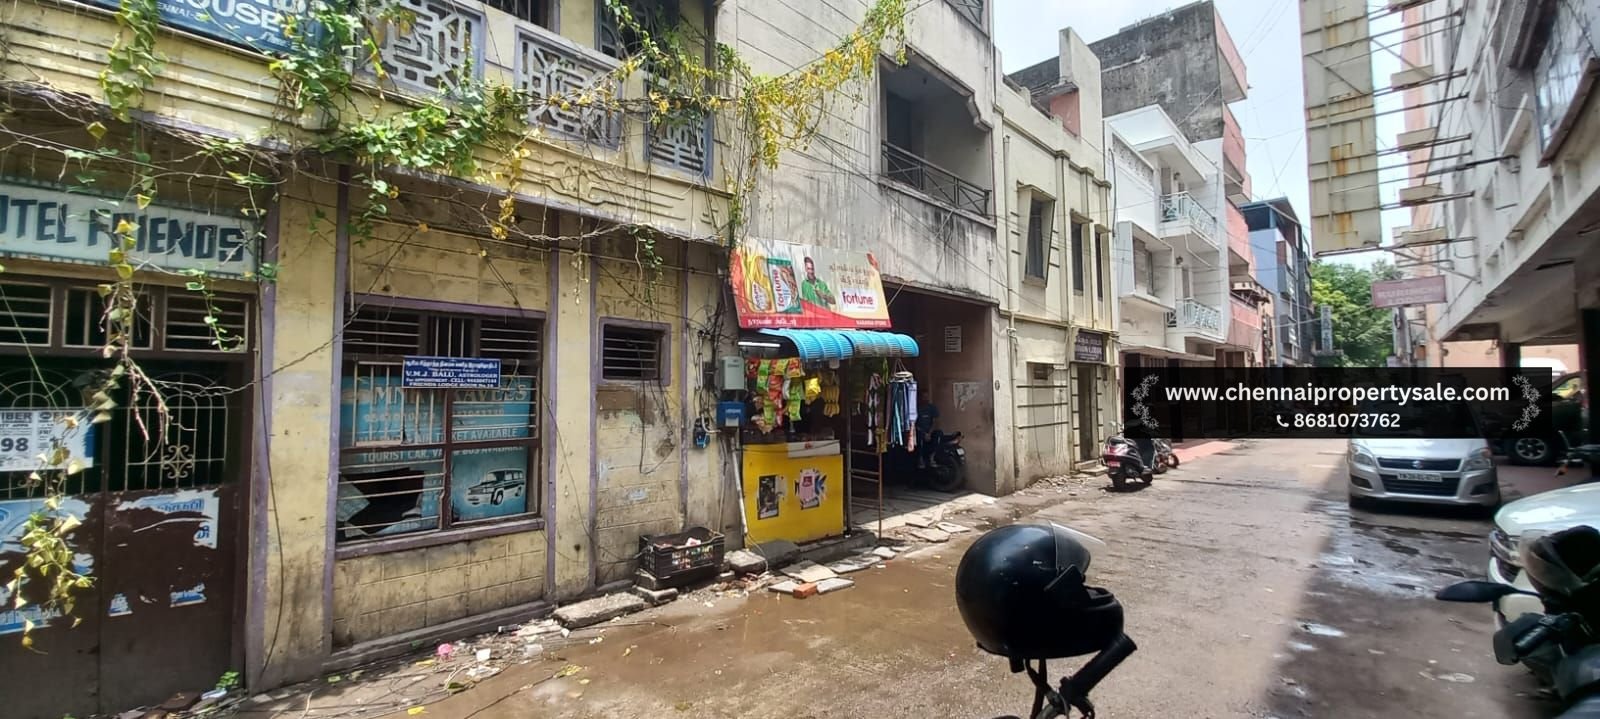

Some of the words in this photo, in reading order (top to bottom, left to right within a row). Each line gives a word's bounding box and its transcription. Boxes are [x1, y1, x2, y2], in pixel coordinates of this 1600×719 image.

[842, 291, 873, 305] fortune
[470, 428, 519, 441] AVAILABLE
[362, 450, 405, 464] TOURIST
